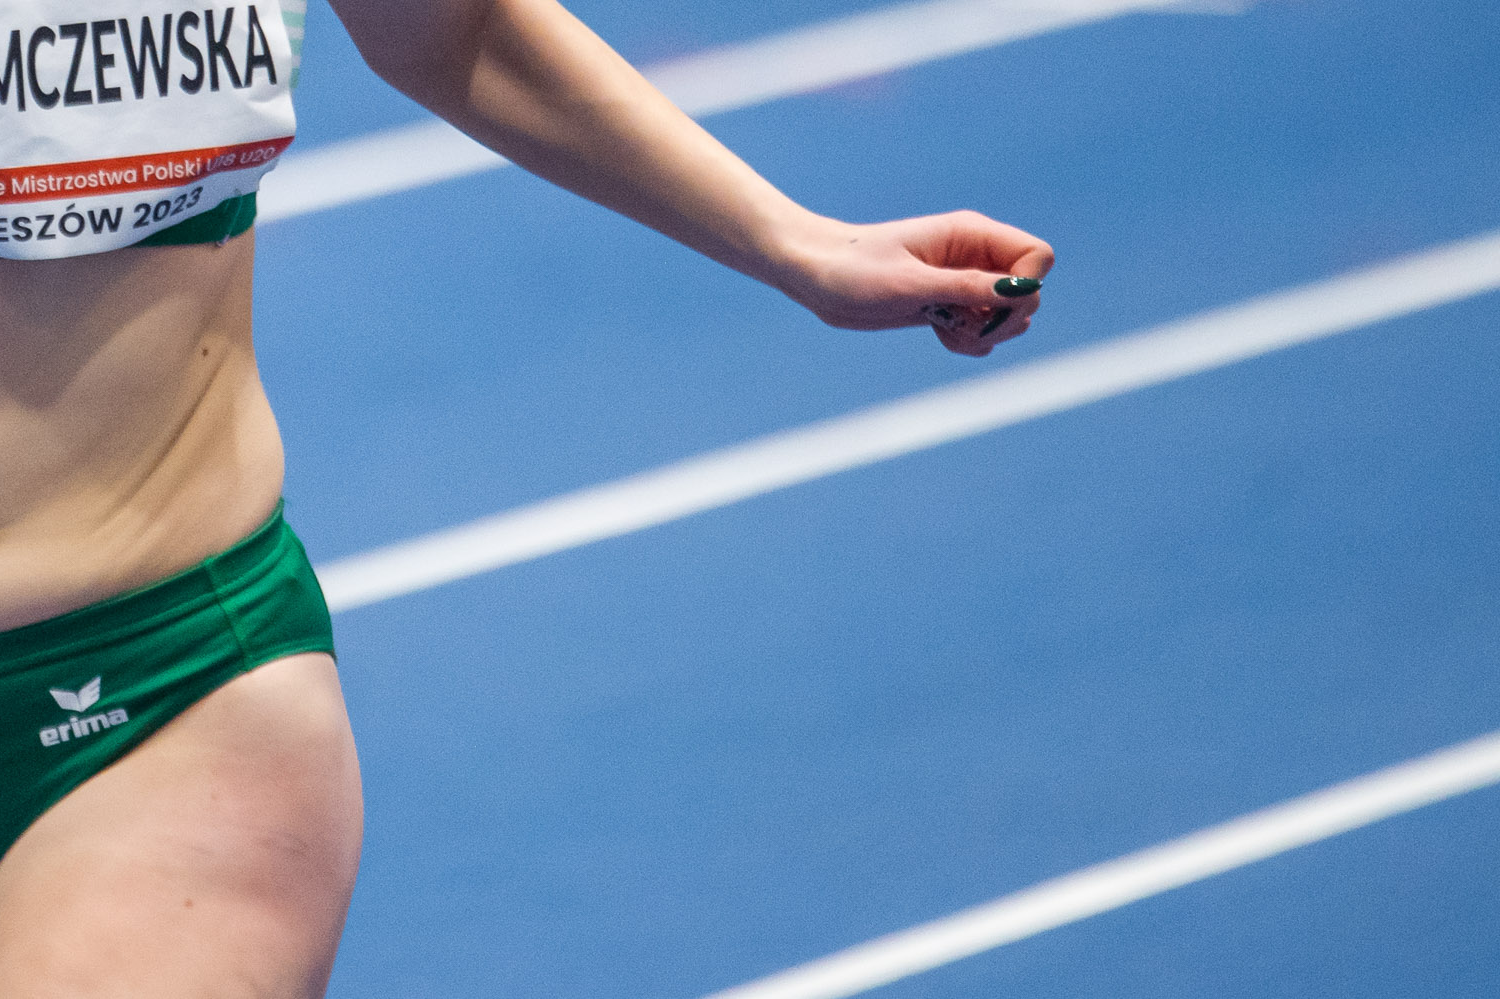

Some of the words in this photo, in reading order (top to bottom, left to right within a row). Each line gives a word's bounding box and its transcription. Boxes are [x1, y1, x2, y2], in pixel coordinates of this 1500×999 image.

[11, 167, 137, 195] Mistrzostwa
[142, 157, 201, 181] Polski
[240, 147, 277, 164] U20
[132, 186, 203, 229] 2023
[39, 708, 129, 747] erima
